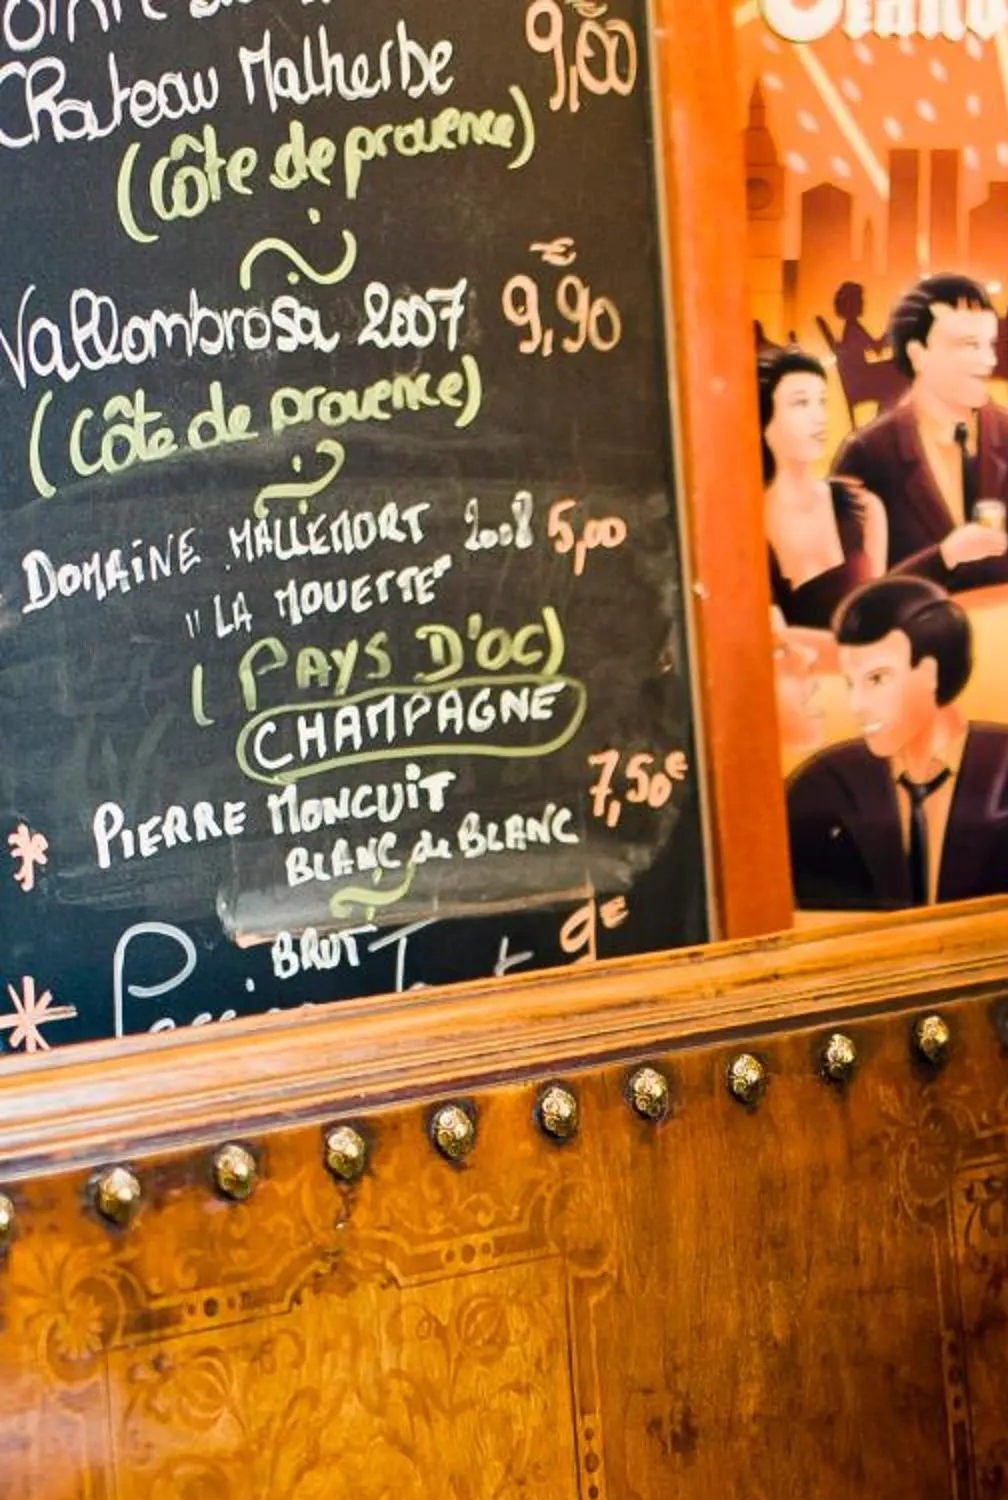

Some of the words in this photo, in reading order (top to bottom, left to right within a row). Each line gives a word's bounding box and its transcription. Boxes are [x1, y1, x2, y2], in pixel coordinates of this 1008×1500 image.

[238, 21, 454, 113] Malherbe
[270, 120, 336, 189] de
[0, 284, 340, 389] Vallombrosa
[357, 277, 467, 351] 2007
[187, 380, 259, 451] de
[252, 681, 566, 771] CHAMPAGNE
[93, 799, 247, 868] PIERRE
[284, 832, 402, 887] BLANC
[456, 802, 580, 859] BLANC
